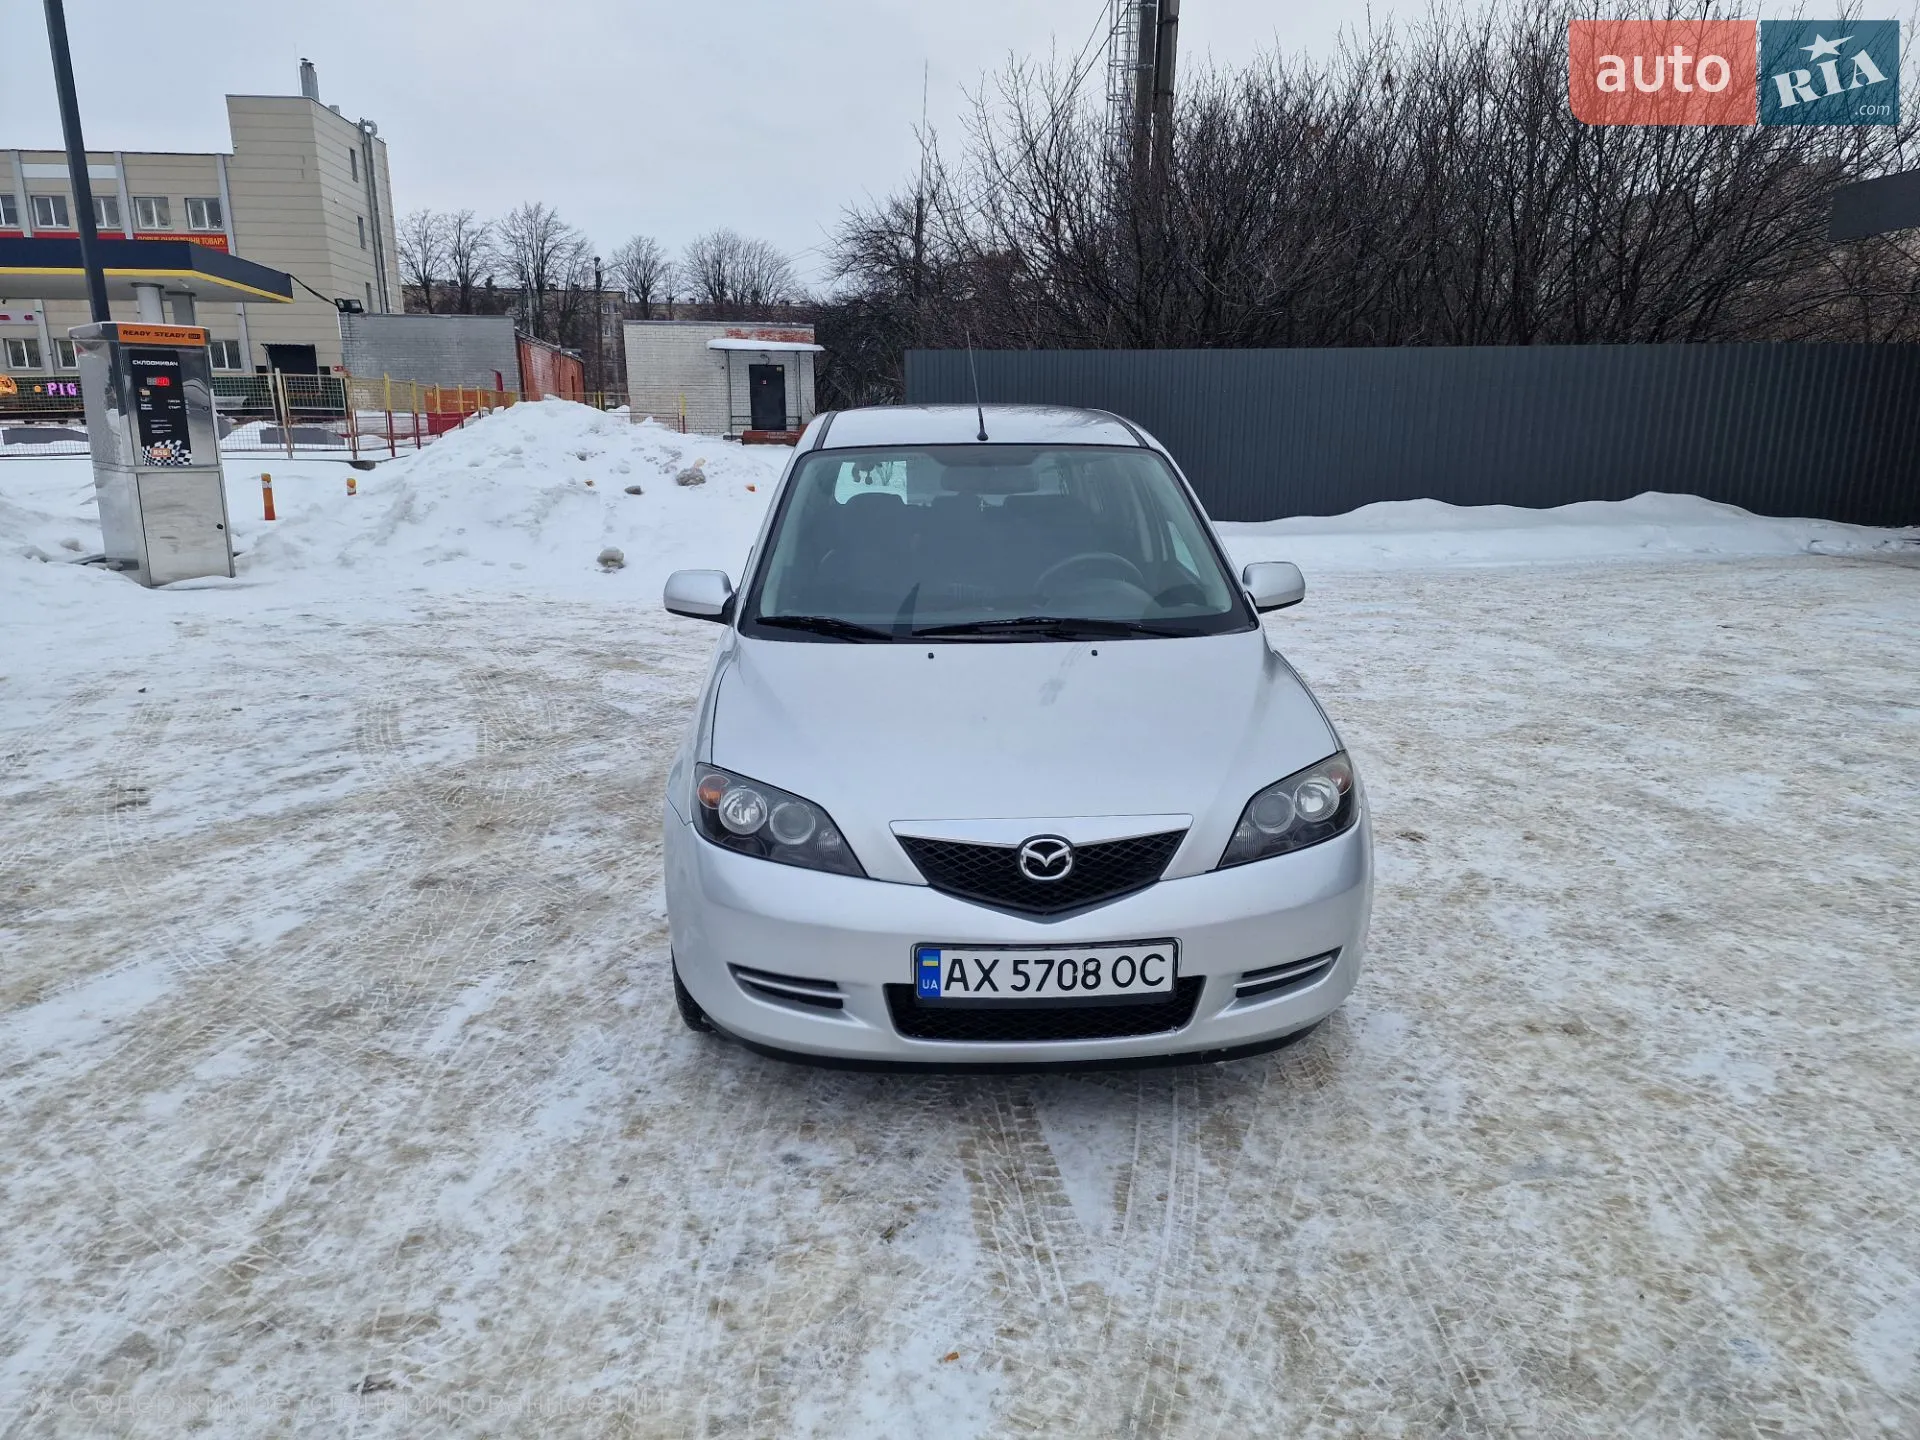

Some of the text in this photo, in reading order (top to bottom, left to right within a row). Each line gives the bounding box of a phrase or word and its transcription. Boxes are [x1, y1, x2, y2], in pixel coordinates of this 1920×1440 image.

[122, 329, 151, 337] READY
[46, 382, 77, 396] PIG
[944, 953, 1166, 992] AX 5708 OC
[922, 979, 938, 990] UA
